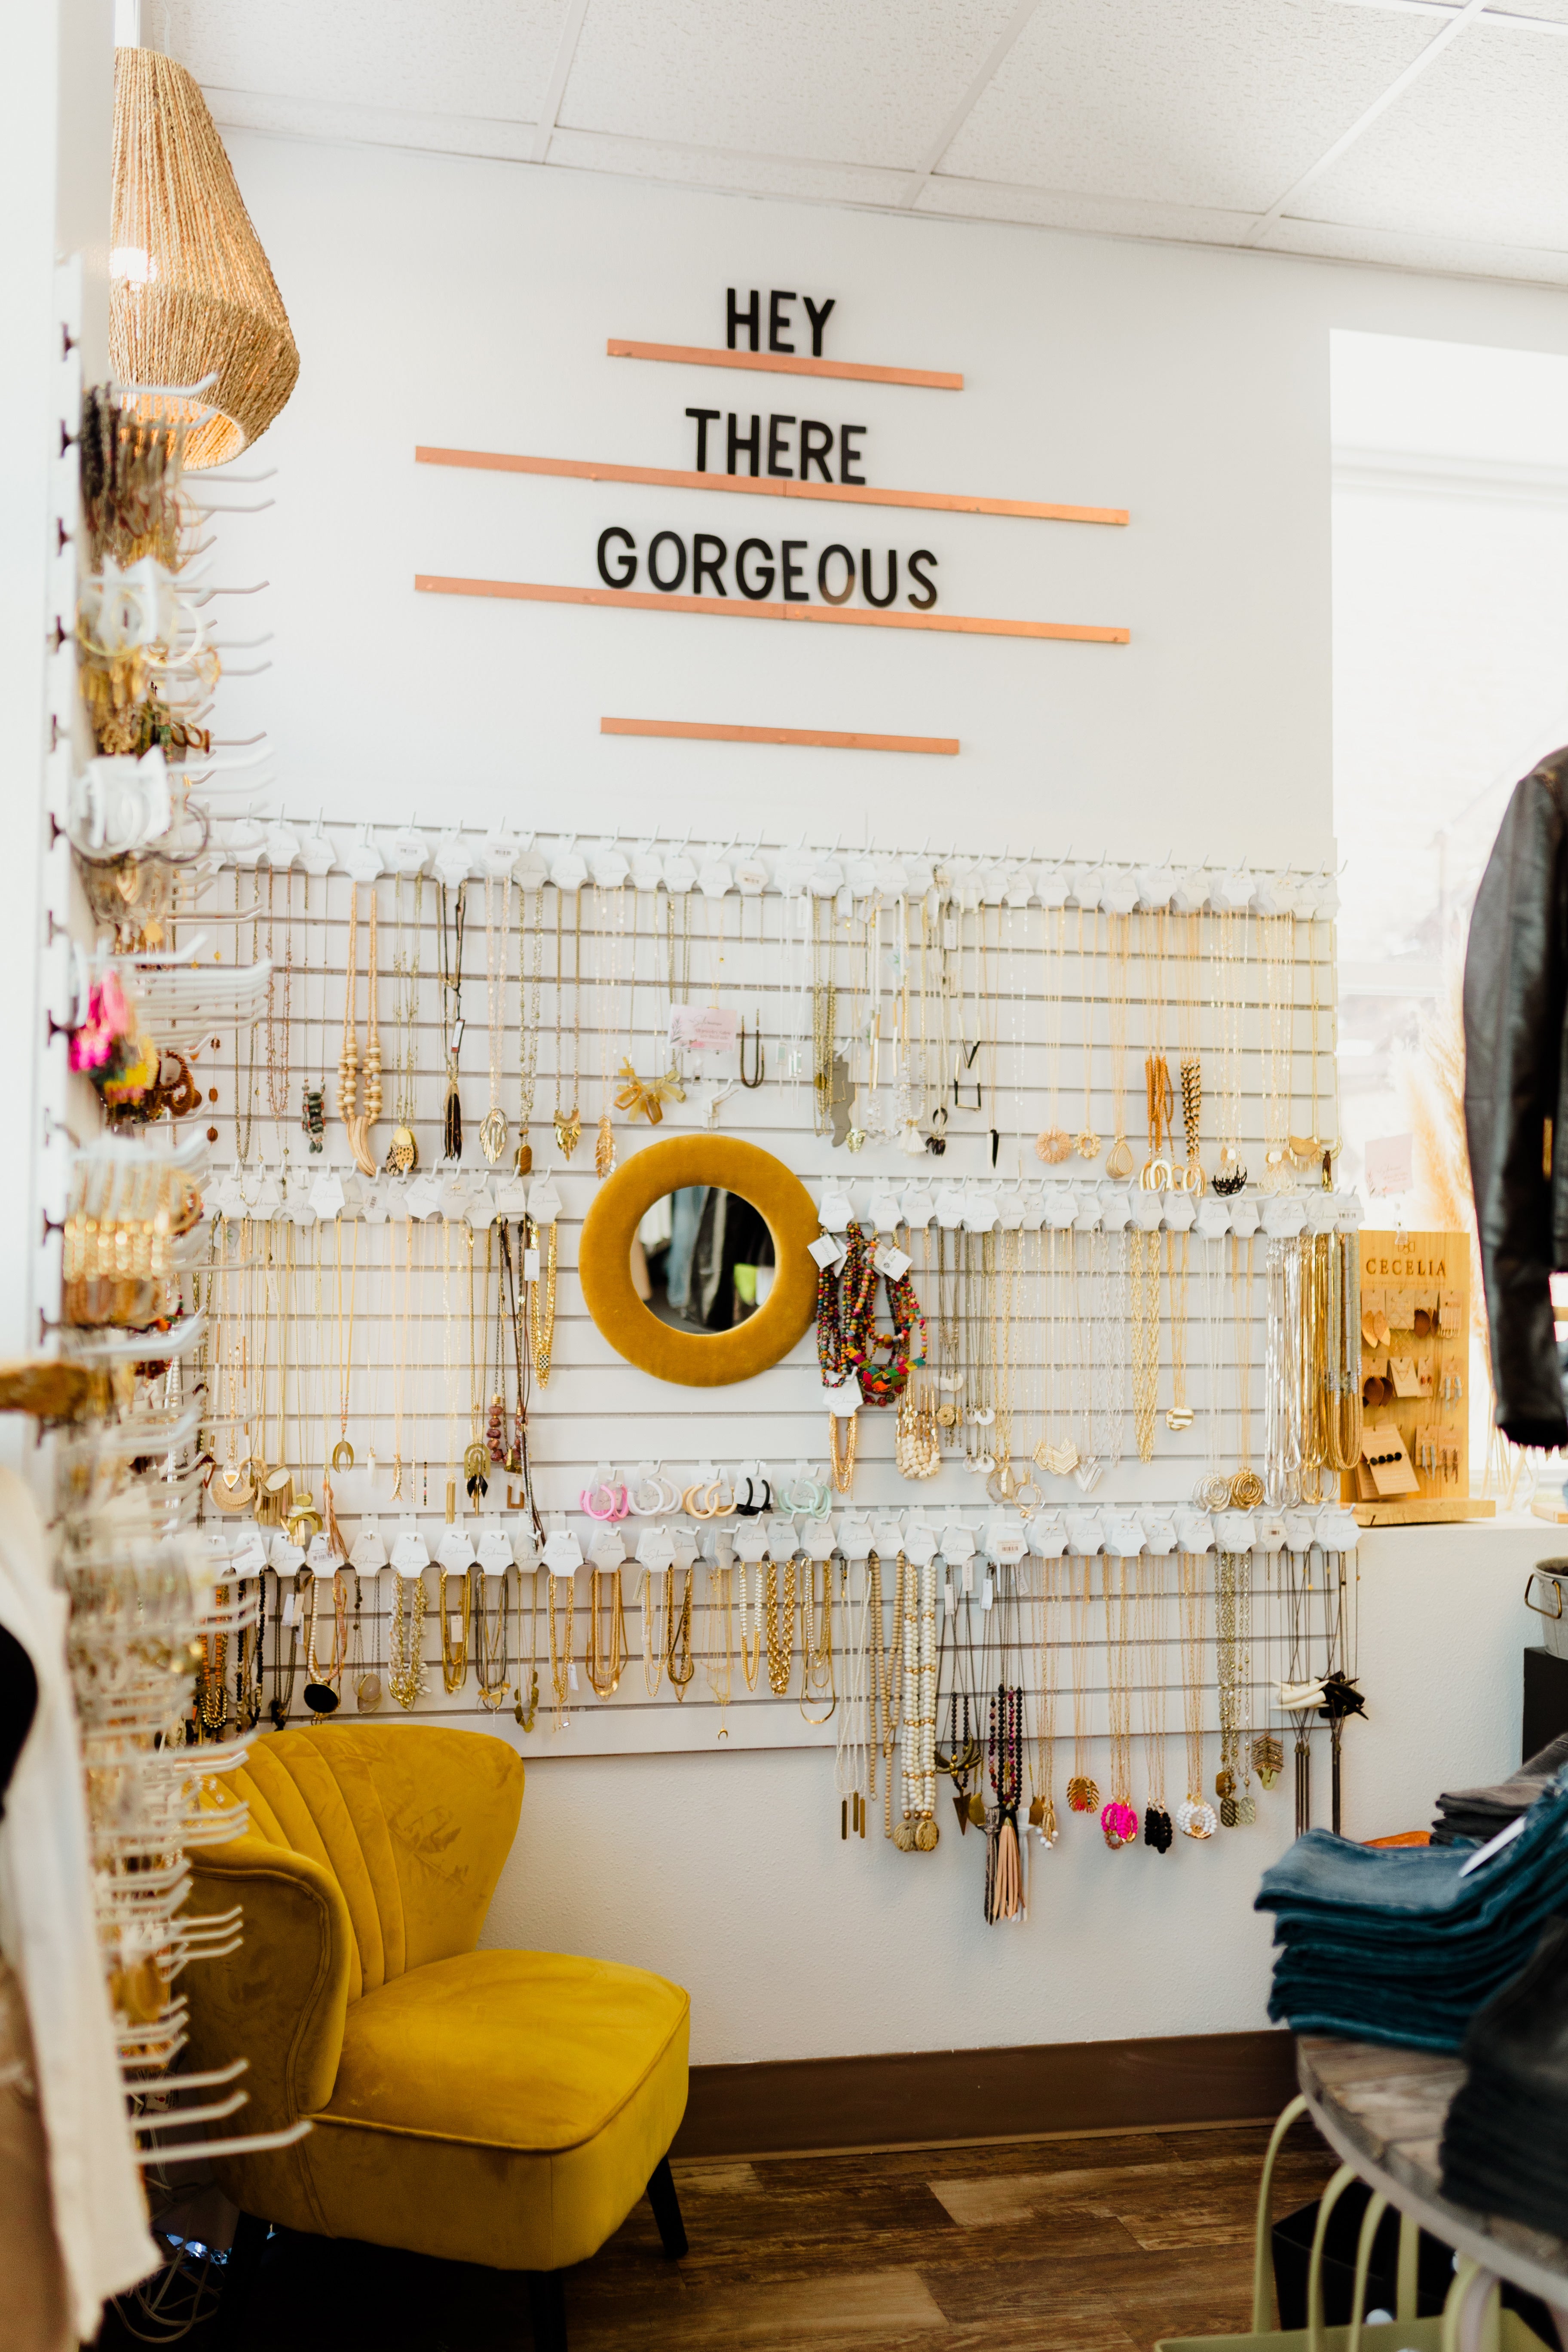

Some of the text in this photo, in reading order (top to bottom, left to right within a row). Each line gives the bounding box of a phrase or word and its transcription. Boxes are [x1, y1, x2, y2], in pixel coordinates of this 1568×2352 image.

[727, 288, 836, 357] HEY
[685, 407, 867, 486] THERE
[597, 527, 938, 610] GORGEOUS
[1366, 1259, 1446, 1277] CECELIA
